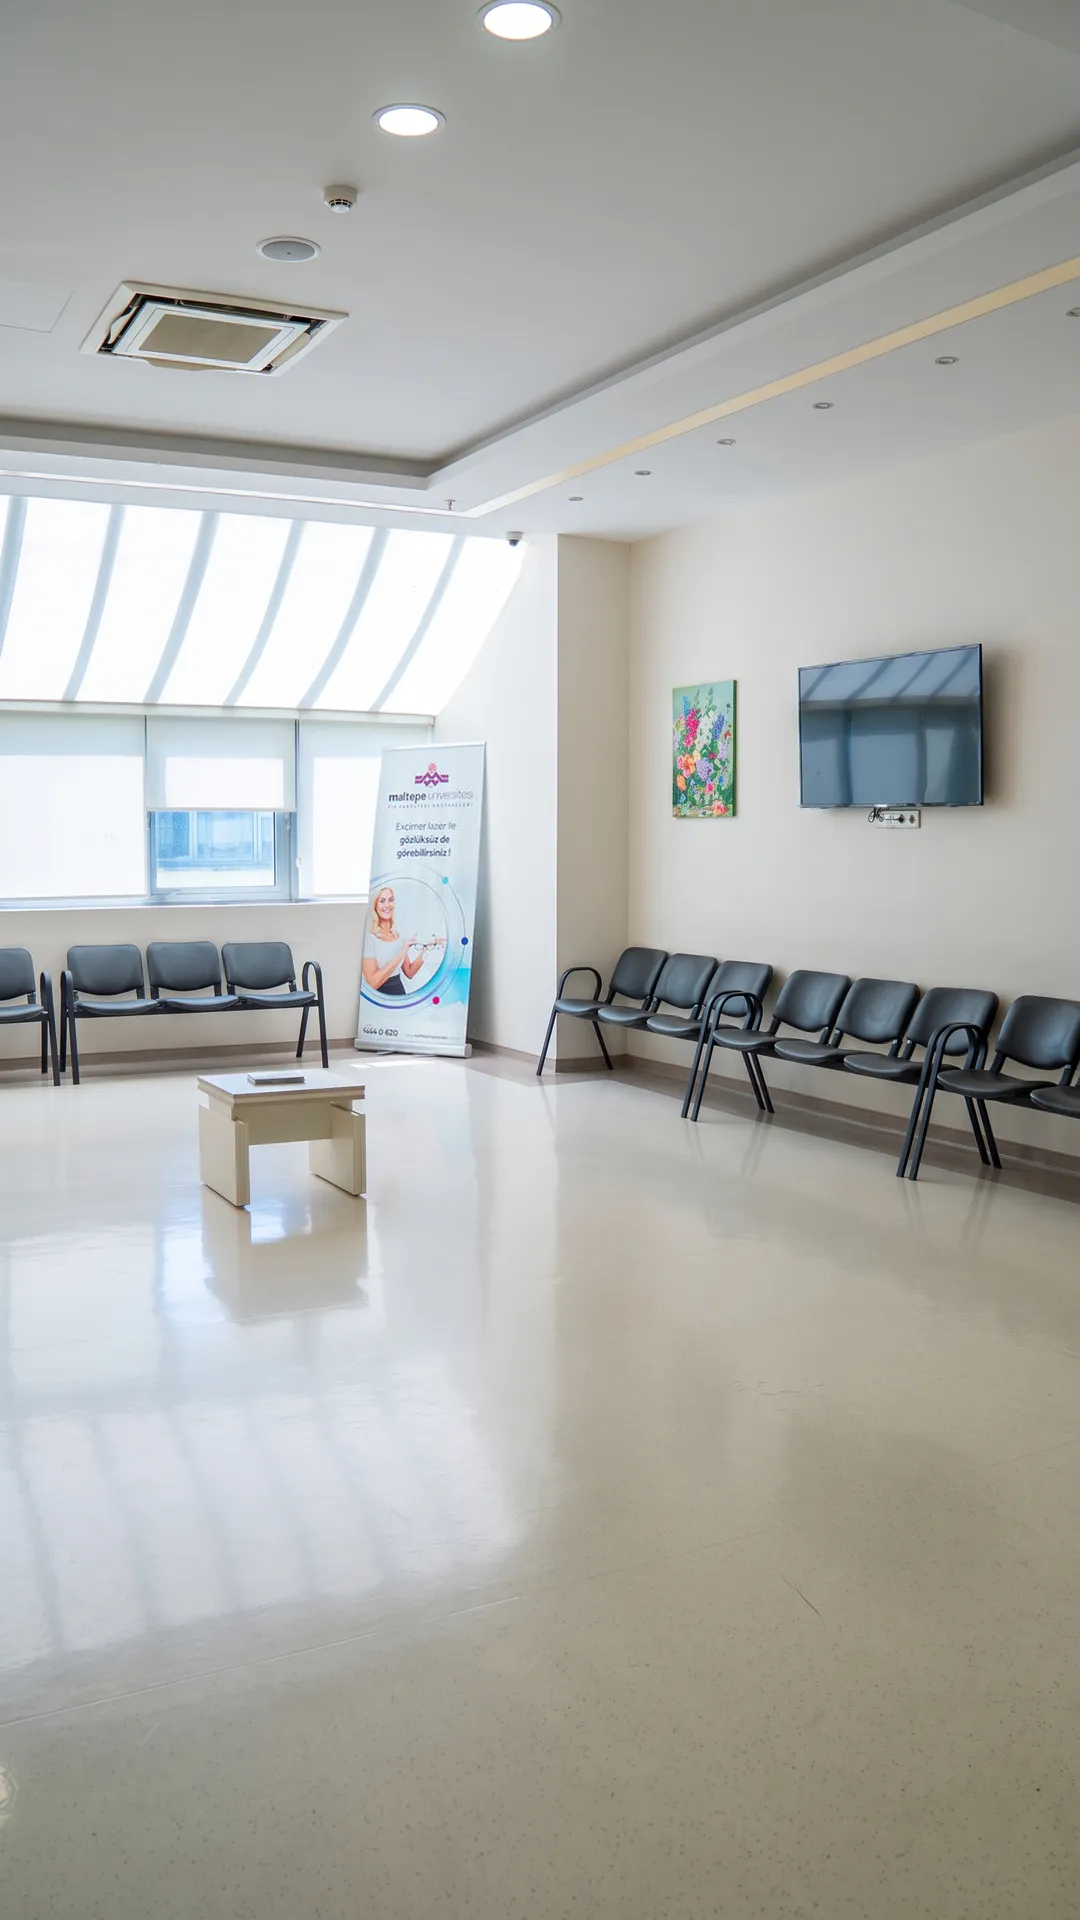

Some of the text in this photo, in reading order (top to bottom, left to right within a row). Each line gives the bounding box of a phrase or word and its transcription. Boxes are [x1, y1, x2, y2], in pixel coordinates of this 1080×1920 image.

[388, 791, 427, 804] maltepe
[396, 822, 426, 831] Excimer
[400, 834, 450, 846] gözlüksüz de
[378, 1028, 384, 1036] 0
[385, 1028, 398, 1037] 620
